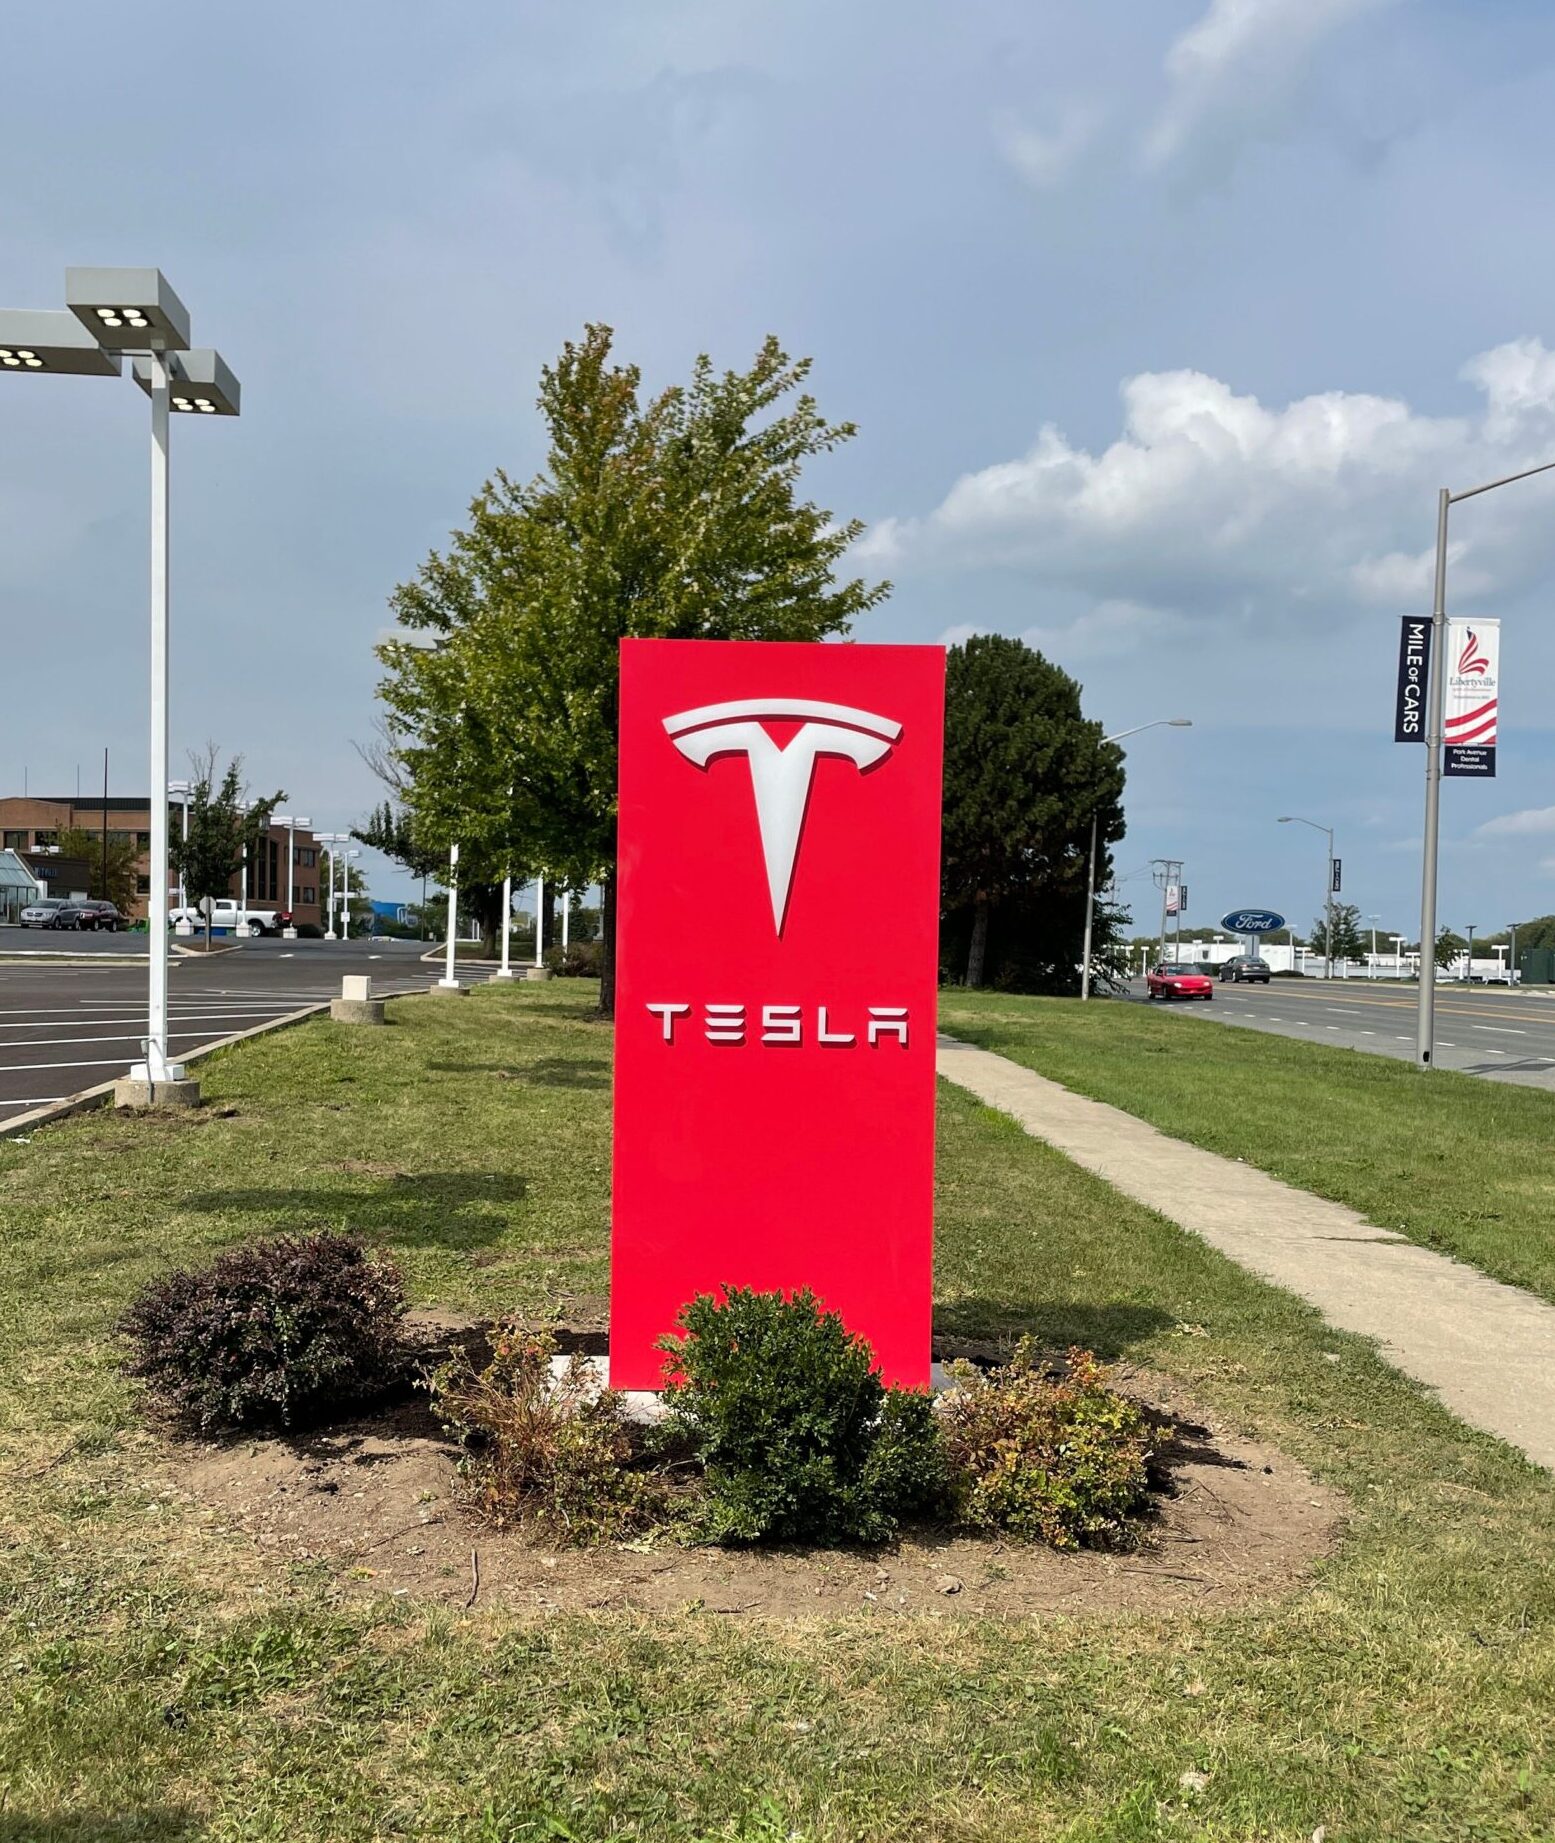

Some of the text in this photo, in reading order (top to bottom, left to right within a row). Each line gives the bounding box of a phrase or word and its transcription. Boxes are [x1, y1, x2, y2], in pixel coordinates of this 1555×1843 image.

[1403, 624, 1425, 733] MILE OF CARS
[1450, 677, 1496, 688] Libertyville
[1236, 914, 1272, 929] Ford
[645, 1003, 908, 1043] TESLA
